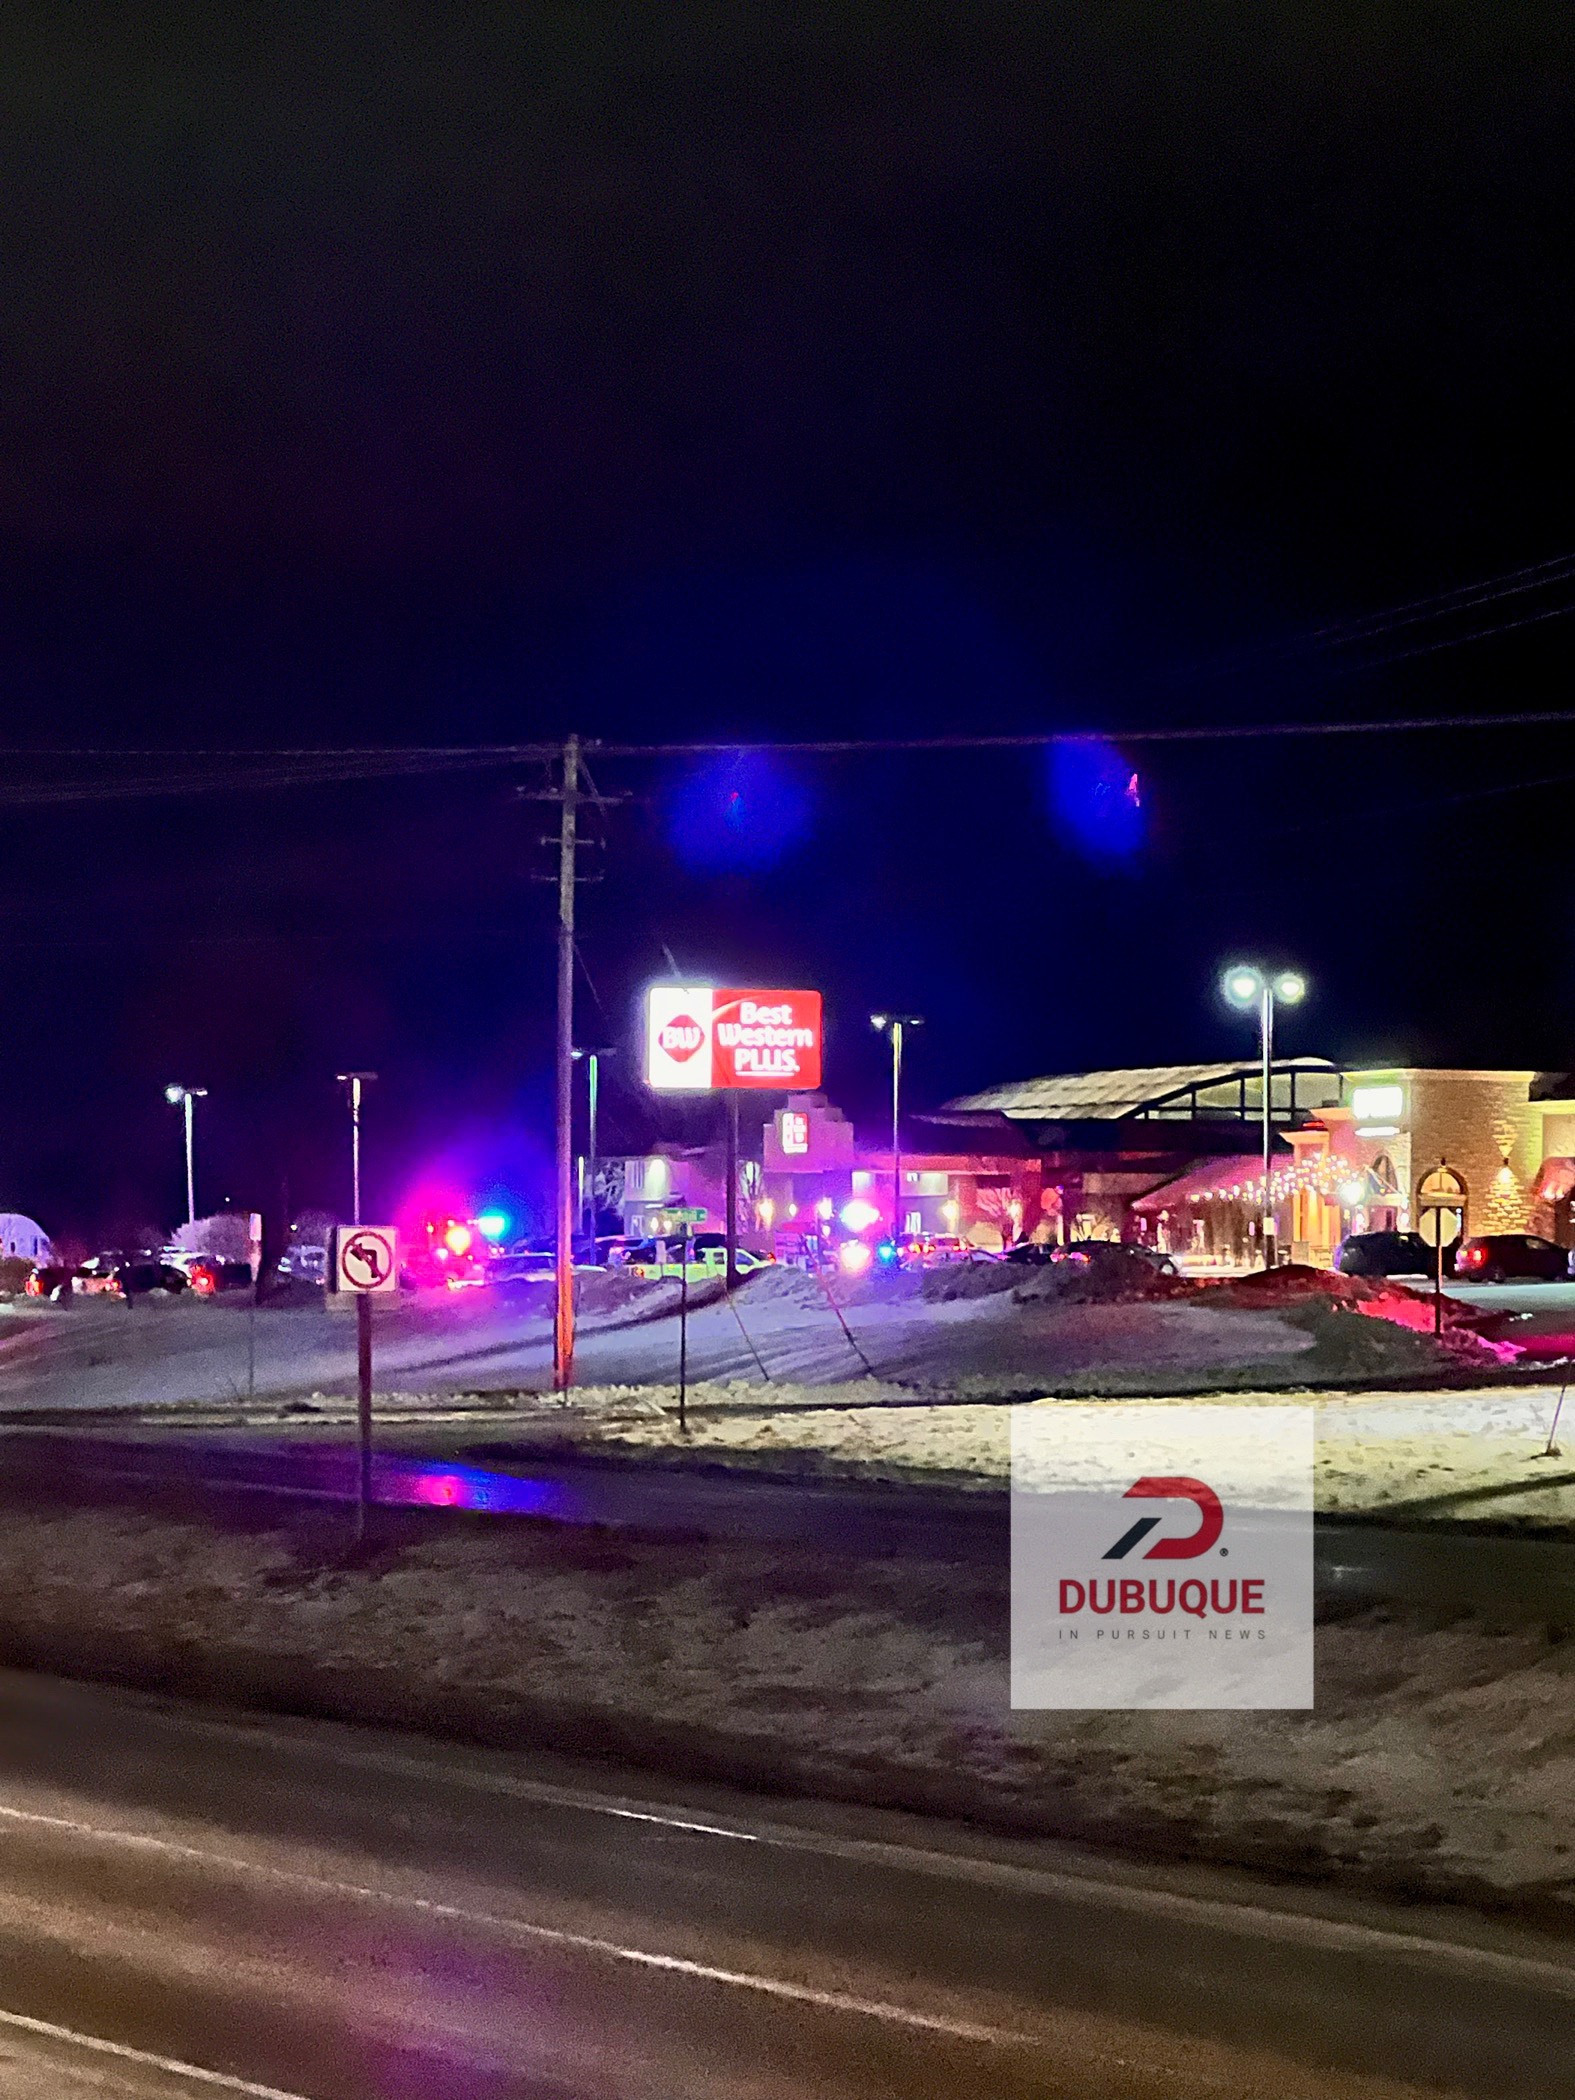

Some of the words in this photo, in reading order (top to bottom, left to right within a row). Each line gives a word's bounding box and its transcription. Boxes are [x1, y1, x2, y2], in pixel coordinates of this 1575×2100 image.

[740, 1002, 792, 1025] Best
[662, 1026, 700, 1049] BW
[717, 1023, 813, 1047] Western
